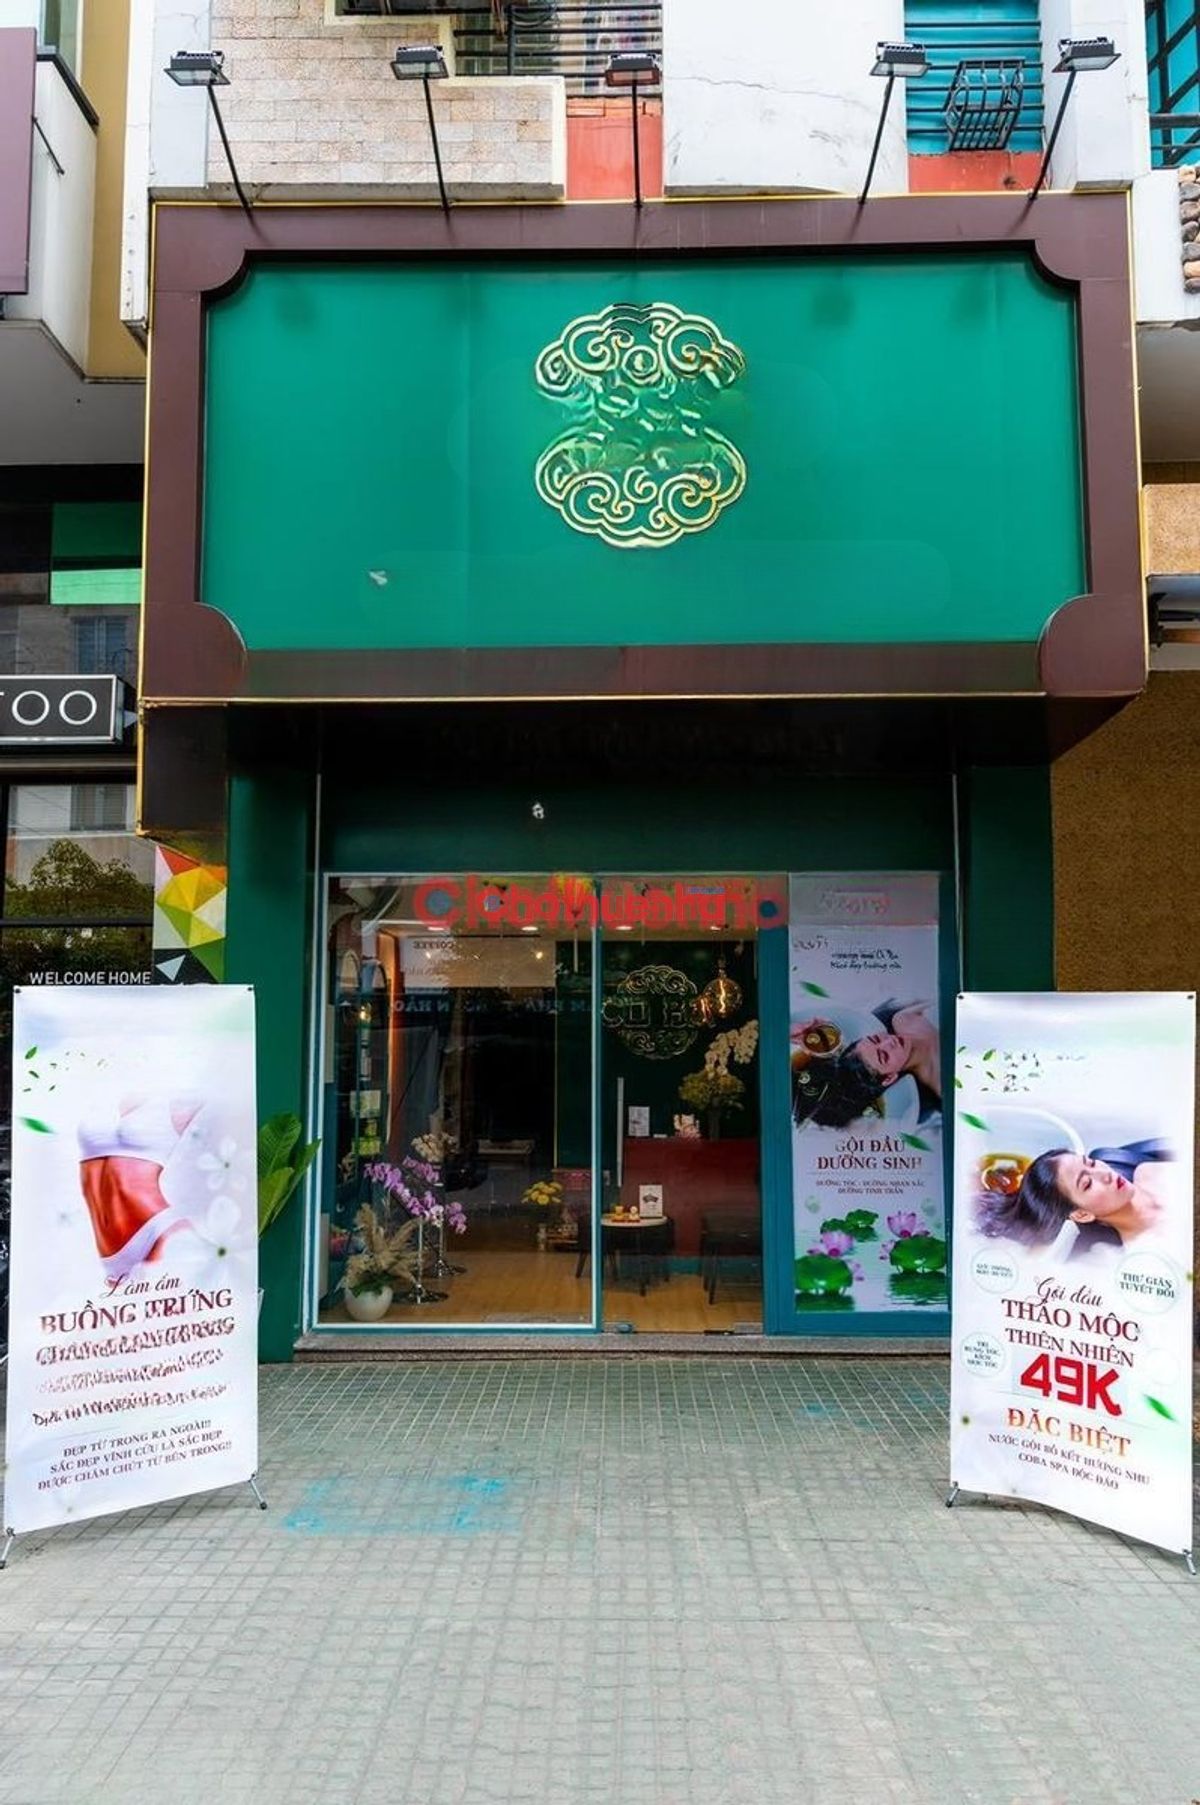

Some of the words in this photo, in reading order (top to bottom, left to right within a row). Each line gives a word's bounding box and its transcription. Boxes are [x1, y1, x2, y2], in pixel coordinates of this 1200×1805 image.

[0, 690, 97, 726] OO
[29, 971, 106, 985] WELCOME
[108, 971, 151, 985] HOME
[817, 1154, 877, 1170] DƯỠNG
[40, 1300, 136, 1334] BUỒNG
[1080, 1312, 1140, 1343] MỘC
[1005, 1328, 1065, 1351] THIÊN
[1070, 1340, 1135, 1368] NHIÊN
[1020, 1353, 1123, 1417] 49K
[1007, 1408, 1061, 1437] ĐẶC
[1069, 1422, 1131, 1457] BIỆT
